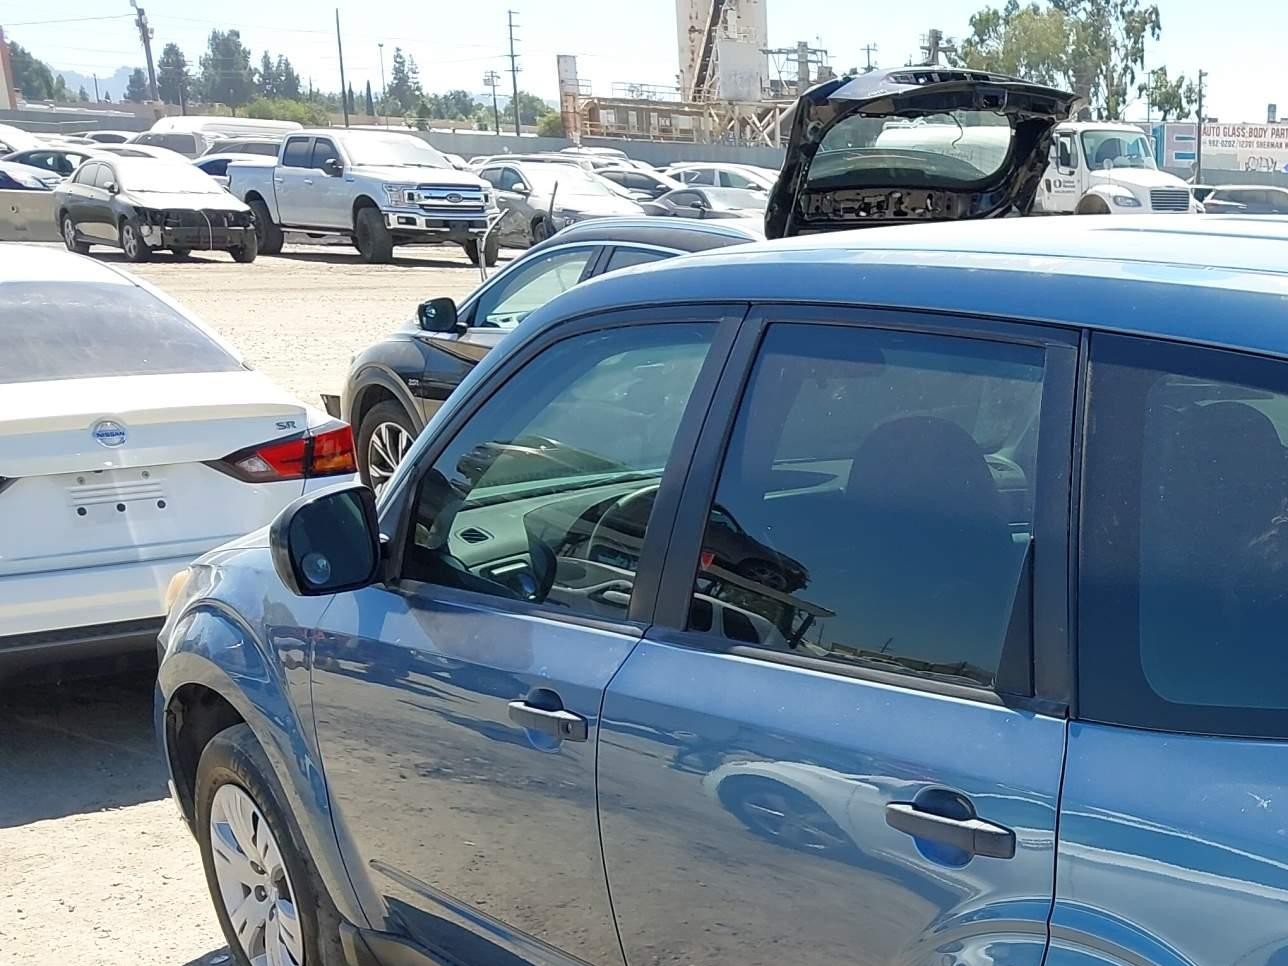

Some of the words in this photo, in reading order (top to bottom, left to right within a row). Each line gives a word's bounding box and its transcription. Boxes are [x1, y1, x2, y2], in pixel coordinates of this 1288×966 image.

[1202, 126, 1221, 137] AUTO
[1256, 140, 1283, 149] SHERMAN
[275, 420, 297, 430] SR
